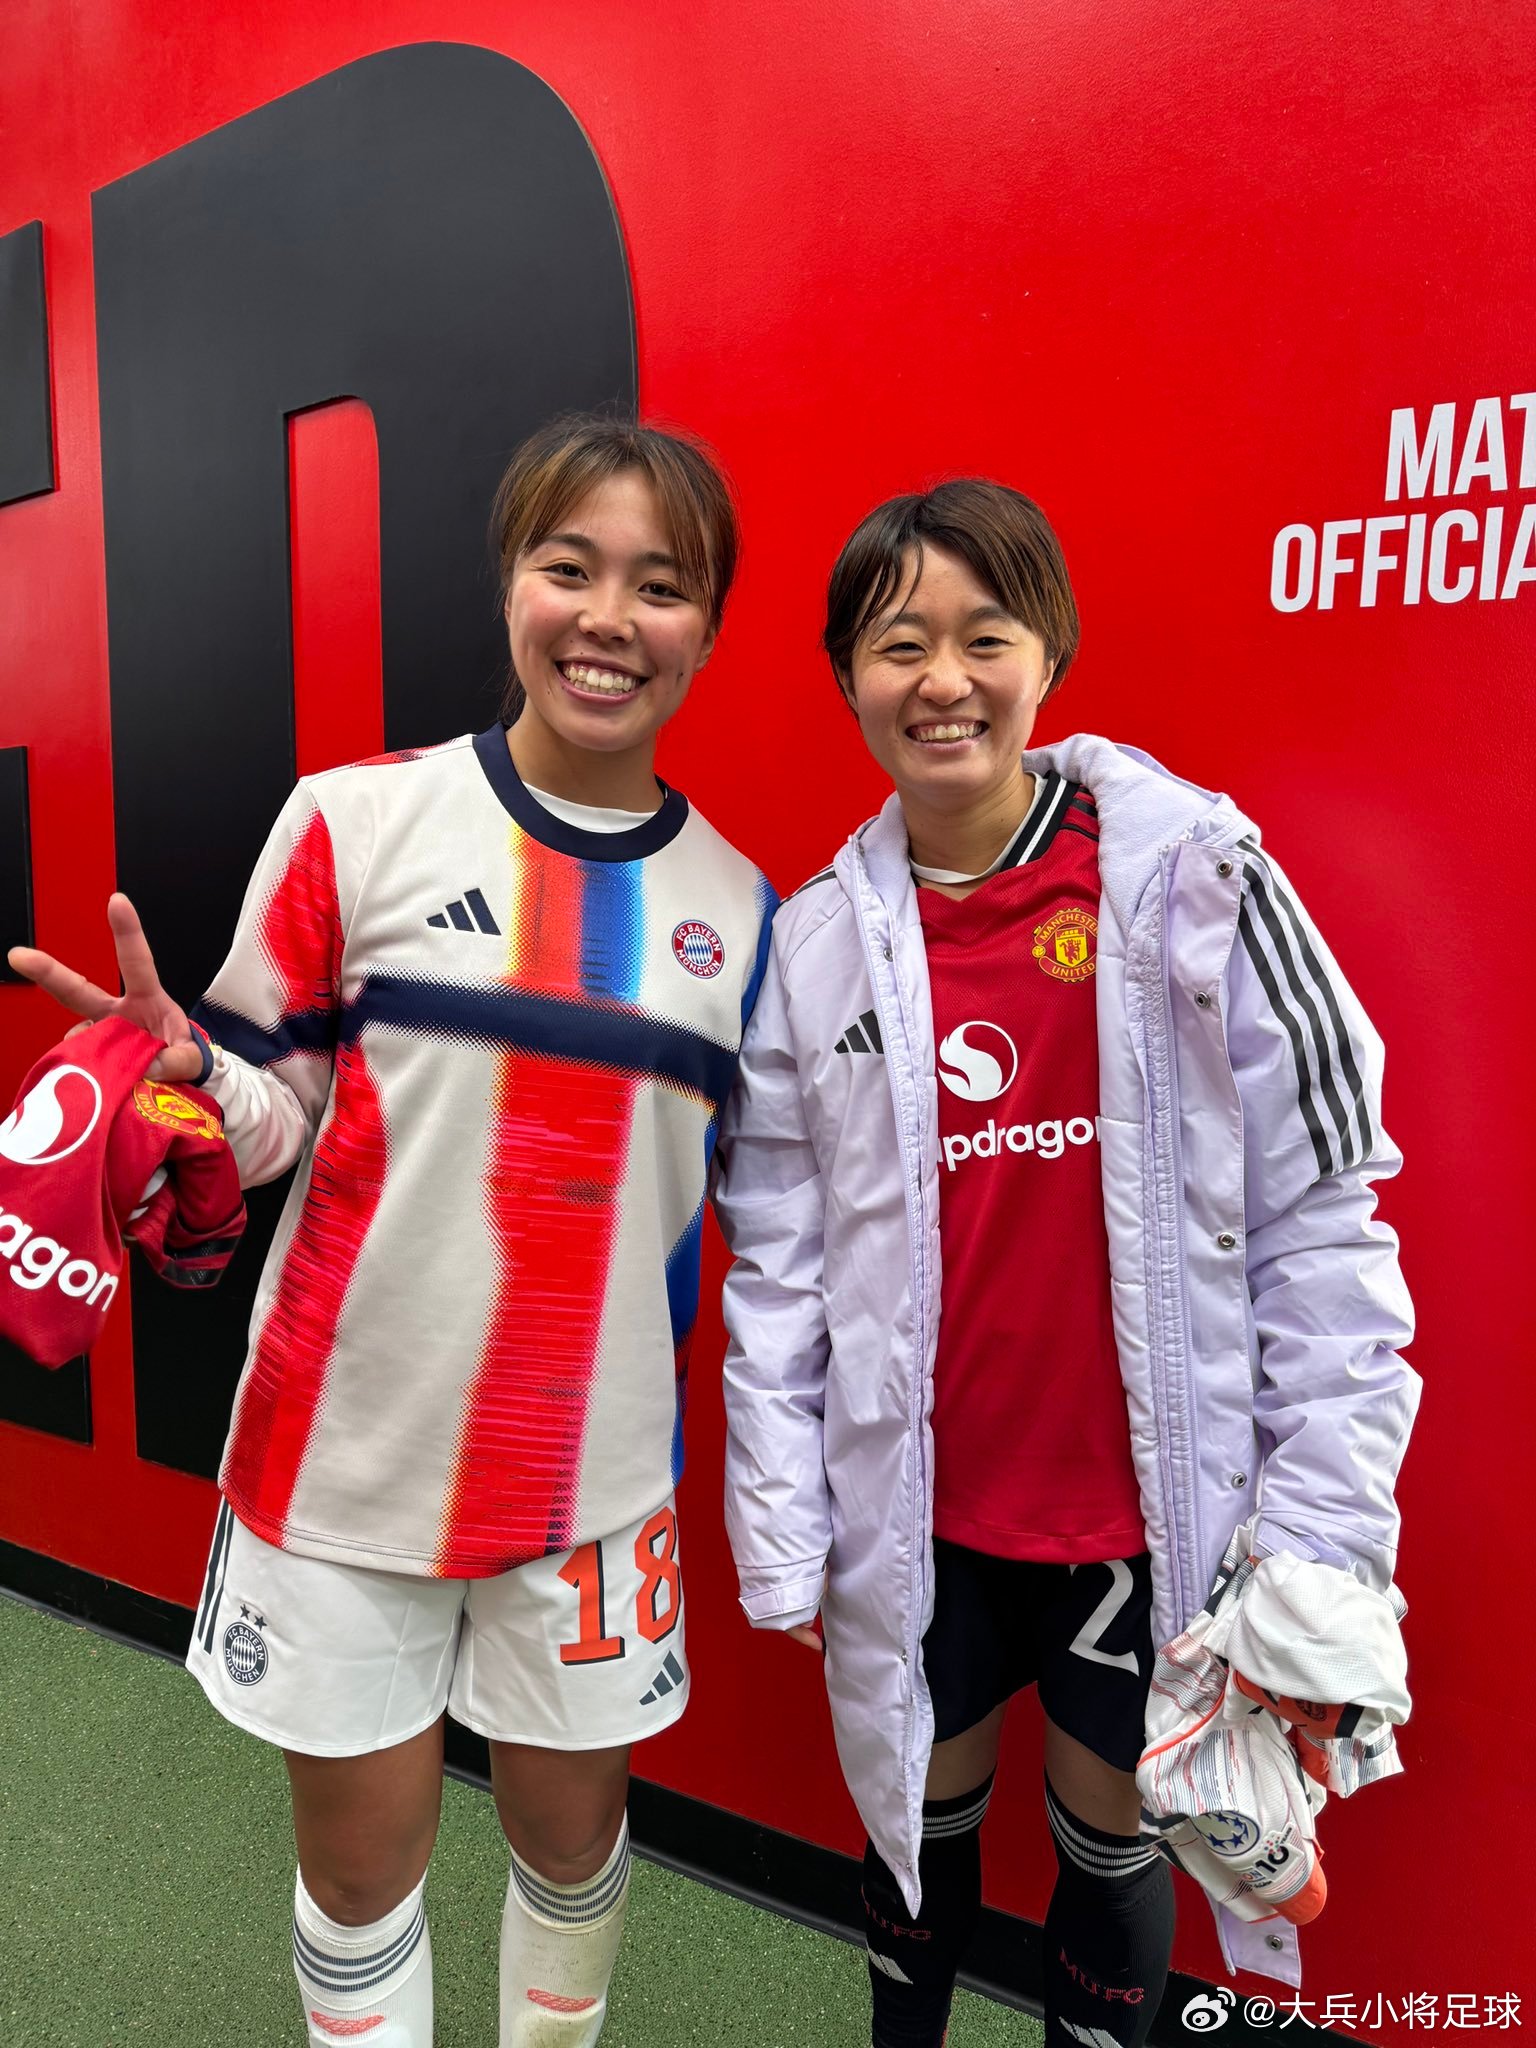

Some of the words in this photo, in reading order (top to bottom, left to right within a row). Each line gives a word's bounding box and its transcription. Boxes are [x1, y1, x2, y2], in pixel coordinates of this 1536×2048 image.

[1270, 503, 1536, 613] OFFICIA
[676, 928, 688, 942] FC
[687, 924, 721, 952] BAYERN
[1051, 962, 1095, 977] UNITED
[138, 1093, 180, 1127] UNITED
[937, 1115, 1101, 1172] pdrago
[0, 1205, 119, 1313] agon
[557, 1505, 682, 1667] 18
[227, 1628, 238, 1640] FC
[238, 1626, 265, 1660] BAYERN
[1068, 1558, 1140, 1678] 2
